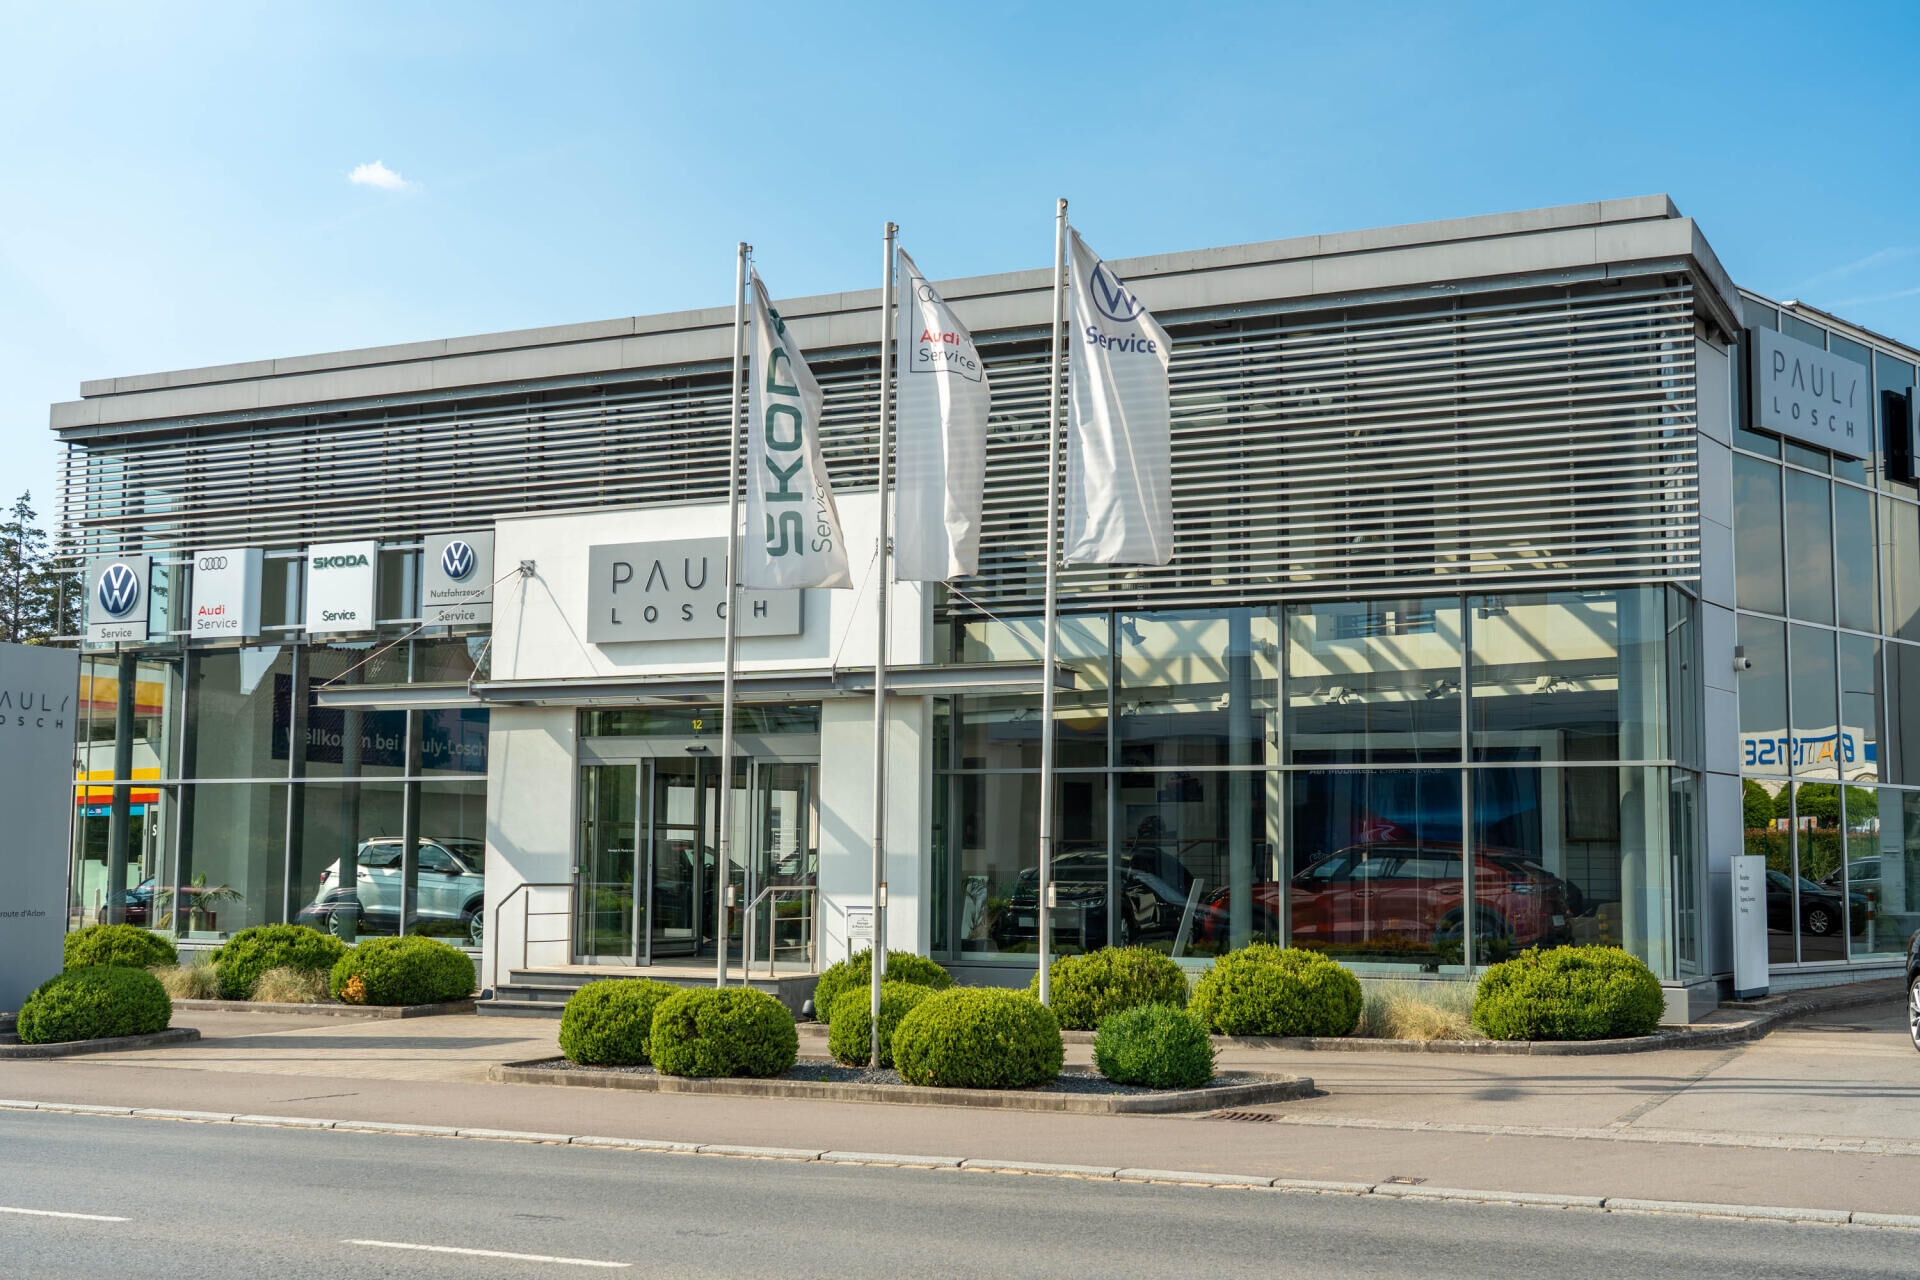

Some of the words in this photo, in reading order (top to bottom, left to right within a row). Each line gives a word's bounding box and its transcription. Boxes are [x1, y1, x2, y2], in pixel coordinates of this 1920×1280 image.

[919, 329, 960, 346] Audi
[1085, 325, 1157, 354] Service
[918, 347, 976, 371] Service
[1773, 349, 1857, 409] PAULY
[1773, 396, 1855, 438] LOSCH
[312, 554, 369, 569] SKODA
[430, 589, 485, 599] Nutzfahrzeuge
[198, 605, 226, 617] Audi
[322, 610, 356, 622] Service
[438, 610, 476, 622] Service
[197, 618, 238, 631] Service
[101, 628, 133, 639] Service
[692, 719, 703, 730] 12
[375, 733, 399, 750] bei
